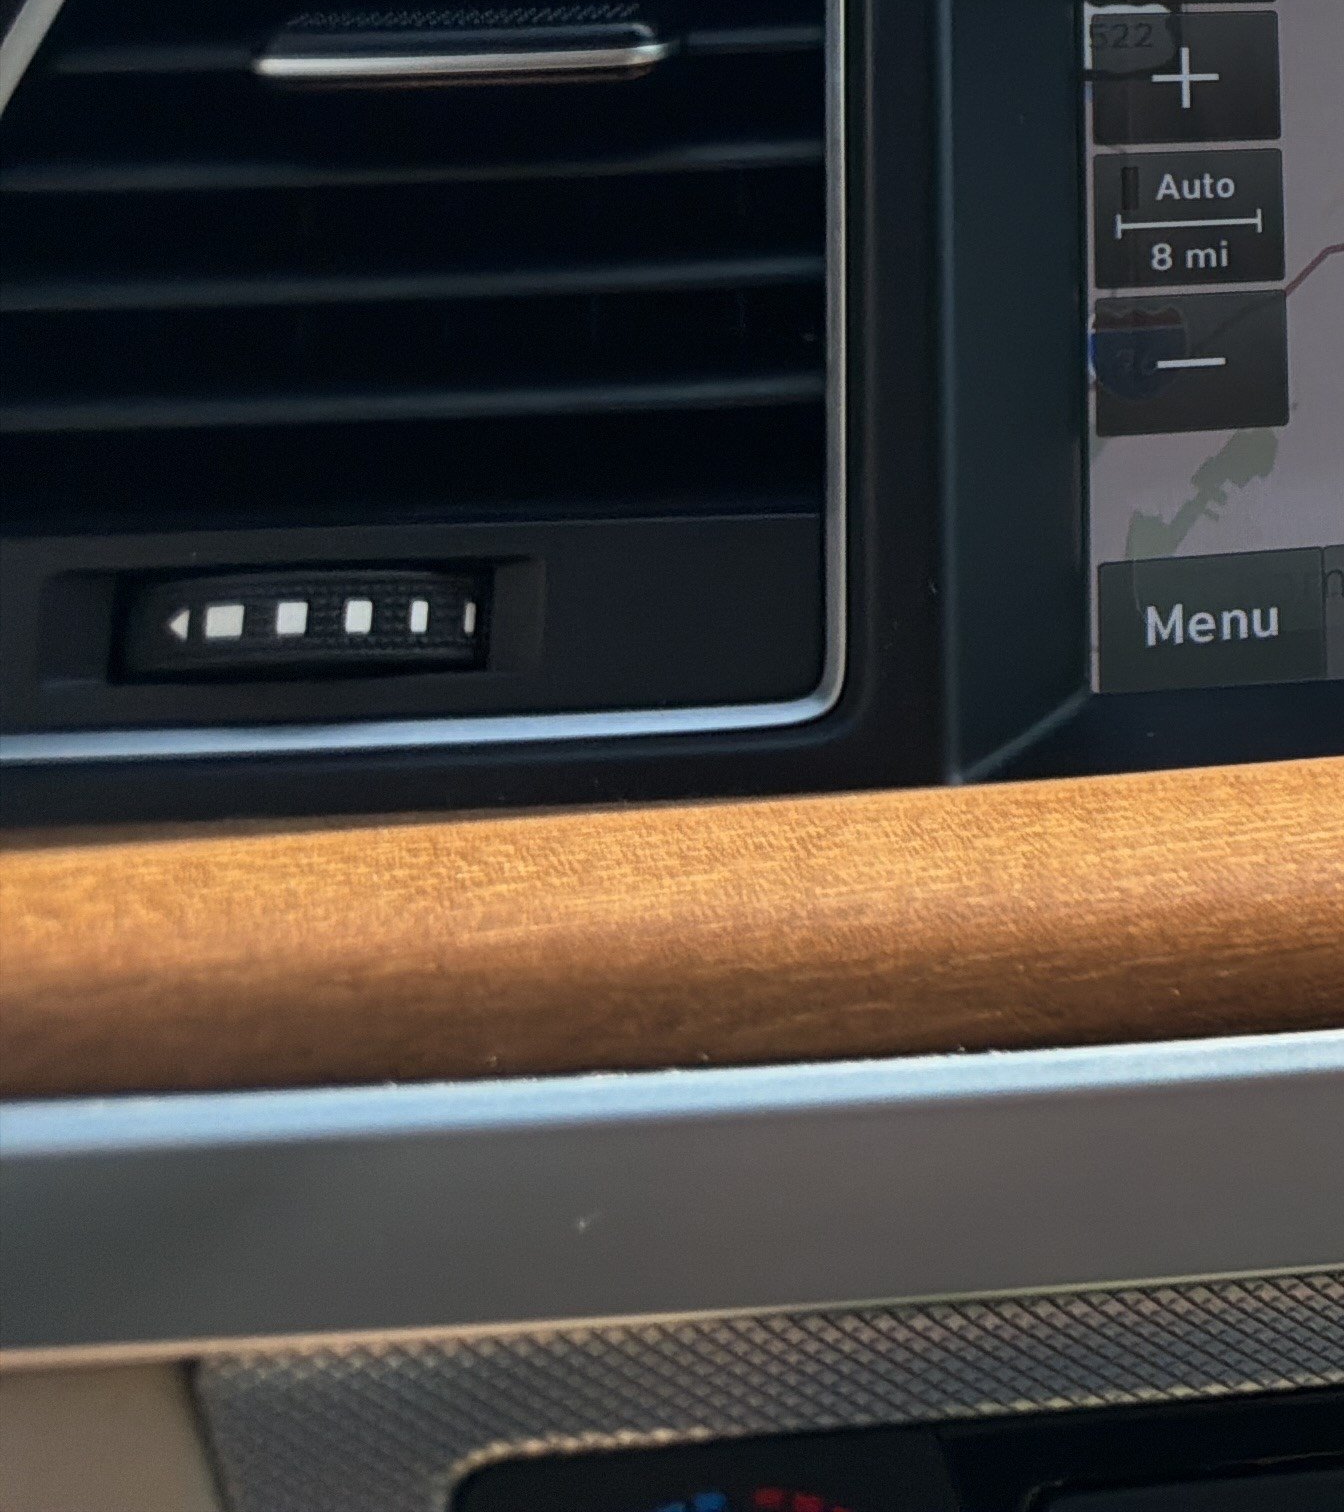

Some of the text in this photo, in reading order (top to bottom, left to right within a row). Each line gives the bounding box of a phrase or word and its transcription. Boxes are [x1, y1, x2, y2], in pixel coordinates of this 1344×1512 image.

[1155, 173, 1236, 201] Auto
[1150, 239, 1230, 272] 8 mi
[1144, 603, 1280, 648] Menu
